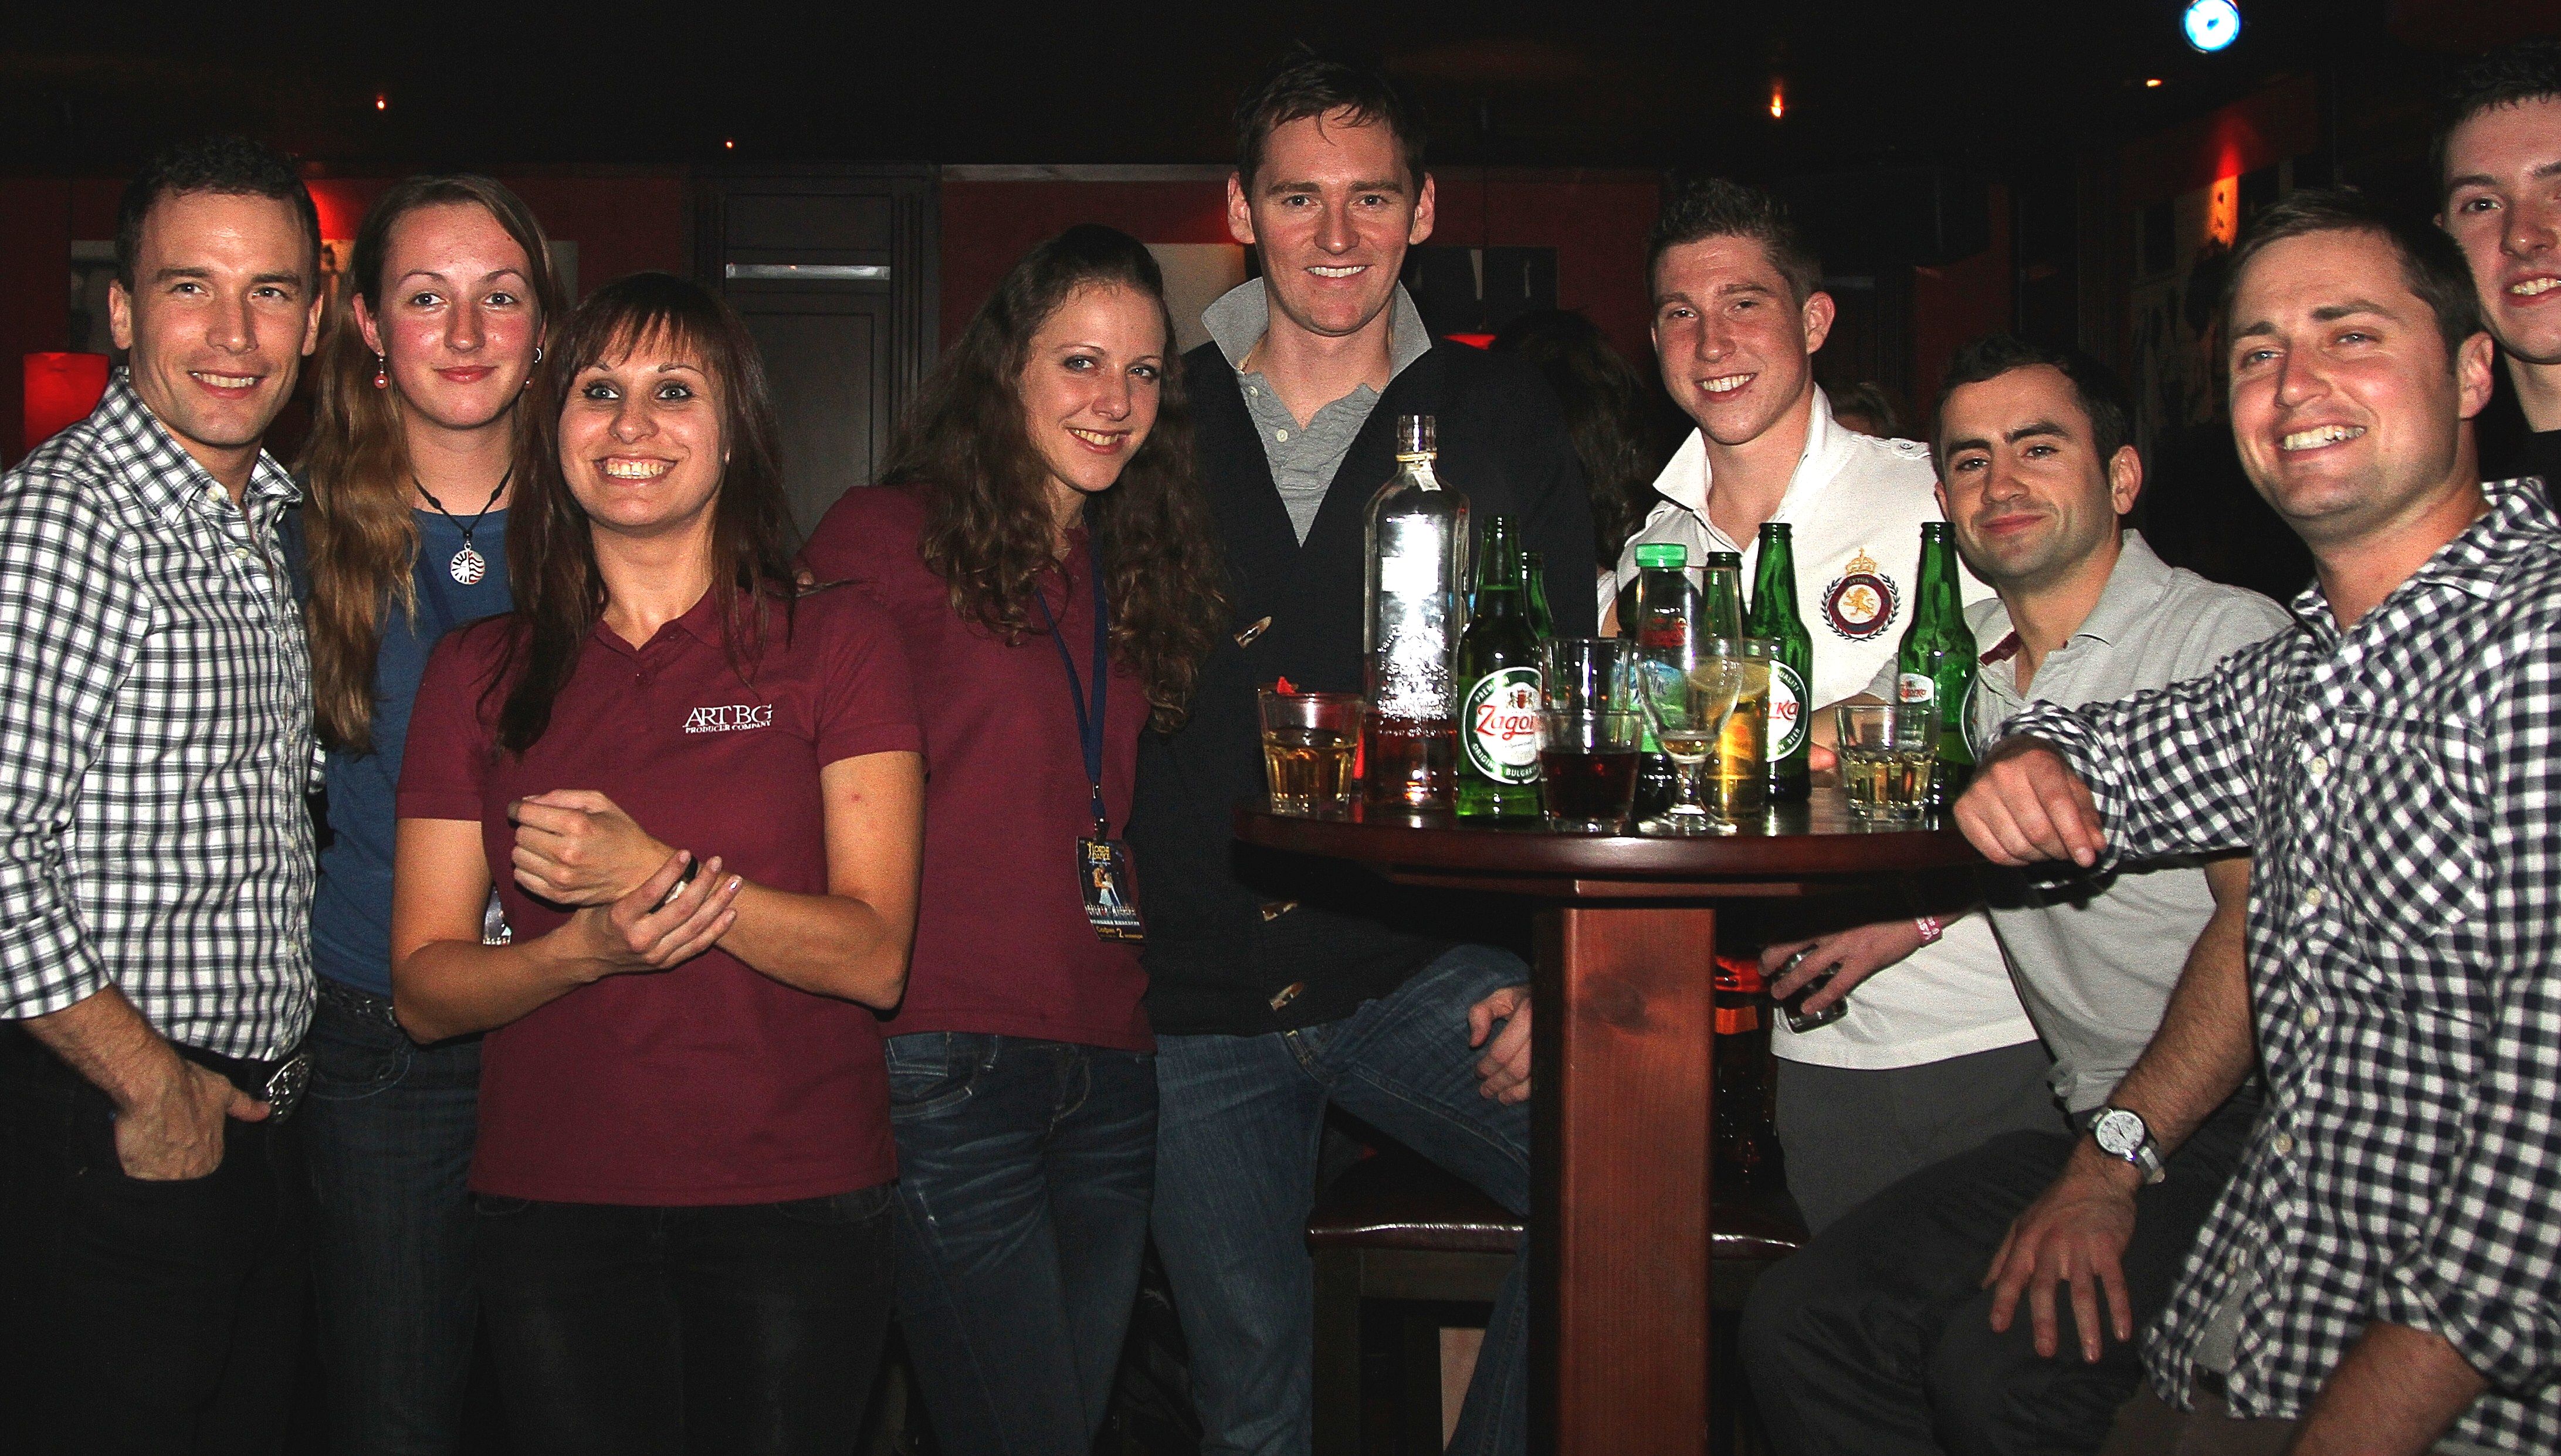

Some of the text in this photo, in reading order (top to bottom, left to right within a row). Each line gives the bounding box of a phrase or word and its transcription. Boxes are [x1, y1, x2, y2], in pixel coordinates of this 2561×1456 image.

[1777, 668, 1800, 691] UALITY
[682, 704, 773, 728] ART BG
[685, 719, 772, 734] PRODUCER COMPANY
[1475, 704, 1539, 741] Zagor
[1472, 742, 1500, 771] ORIGIN
[1506, 765, 1537, 777] BULGAR
